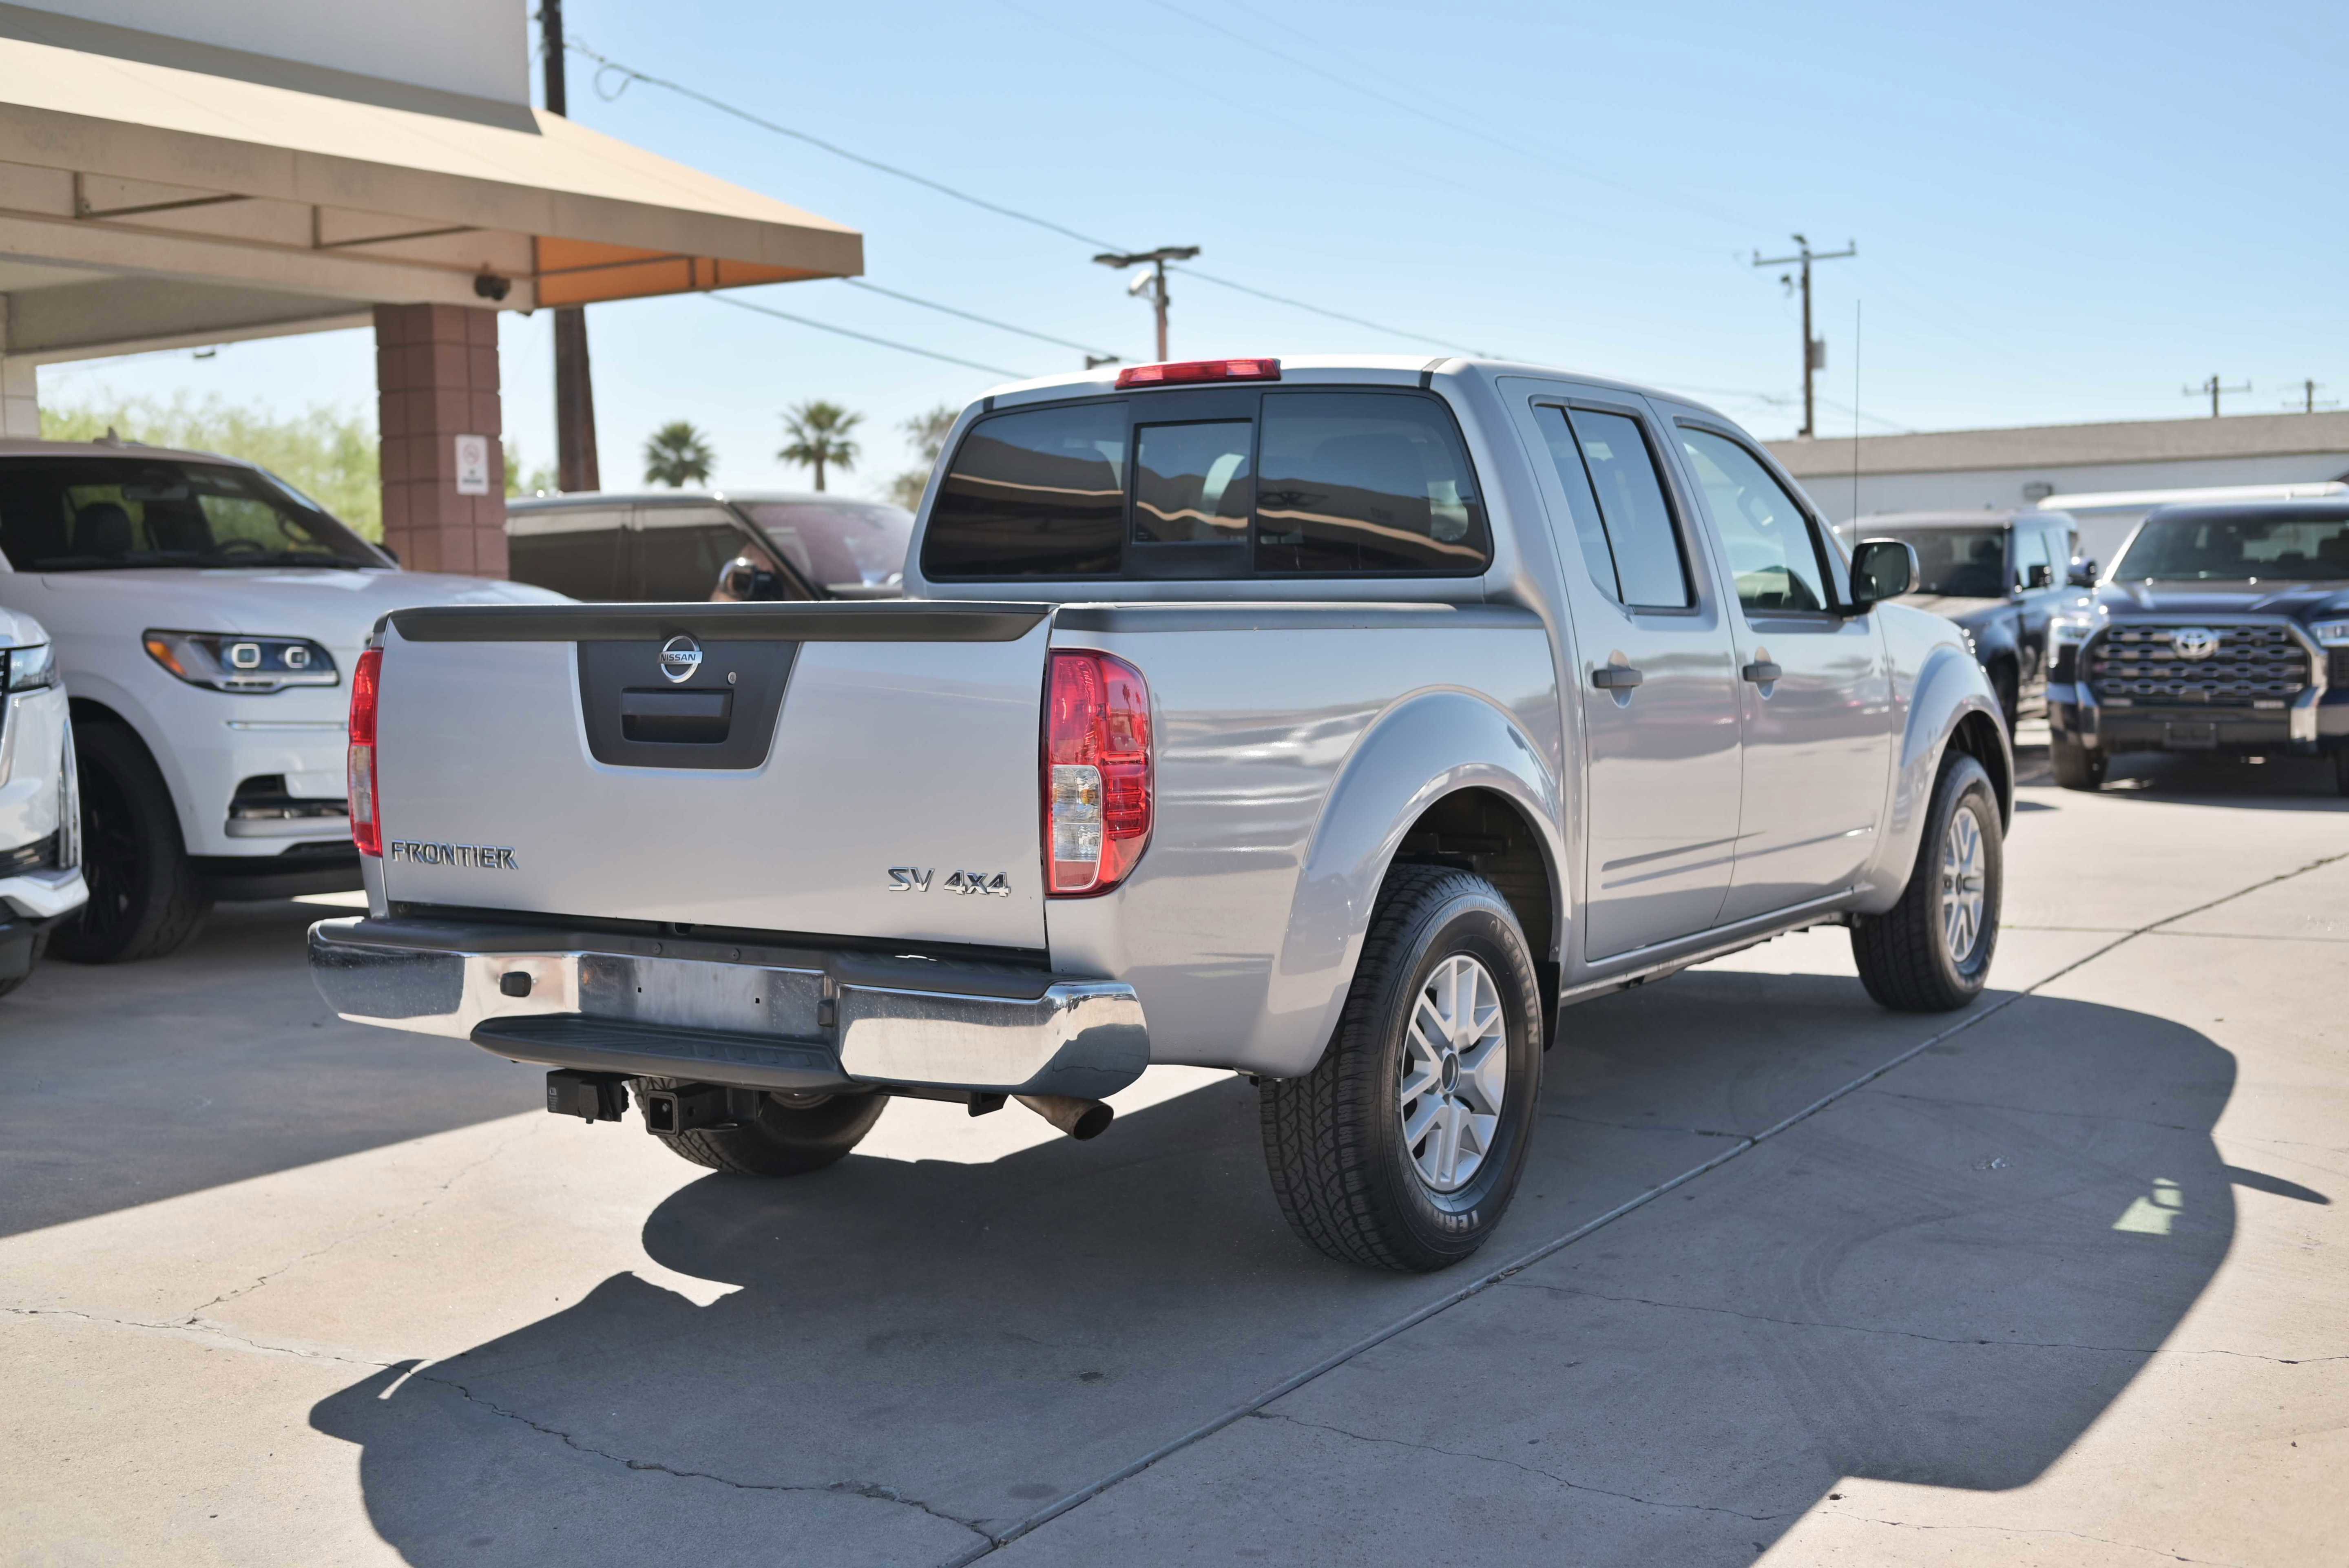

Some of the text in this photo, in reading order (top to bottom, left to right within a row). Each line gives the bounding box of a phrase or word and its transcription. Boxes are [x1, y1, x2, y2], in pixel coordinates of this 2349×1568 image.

[392, 839, 519, 869] FRONTIER
[888, 867, 935, 892] SV
[1500, 930, 1539, 1044] SAILUN
